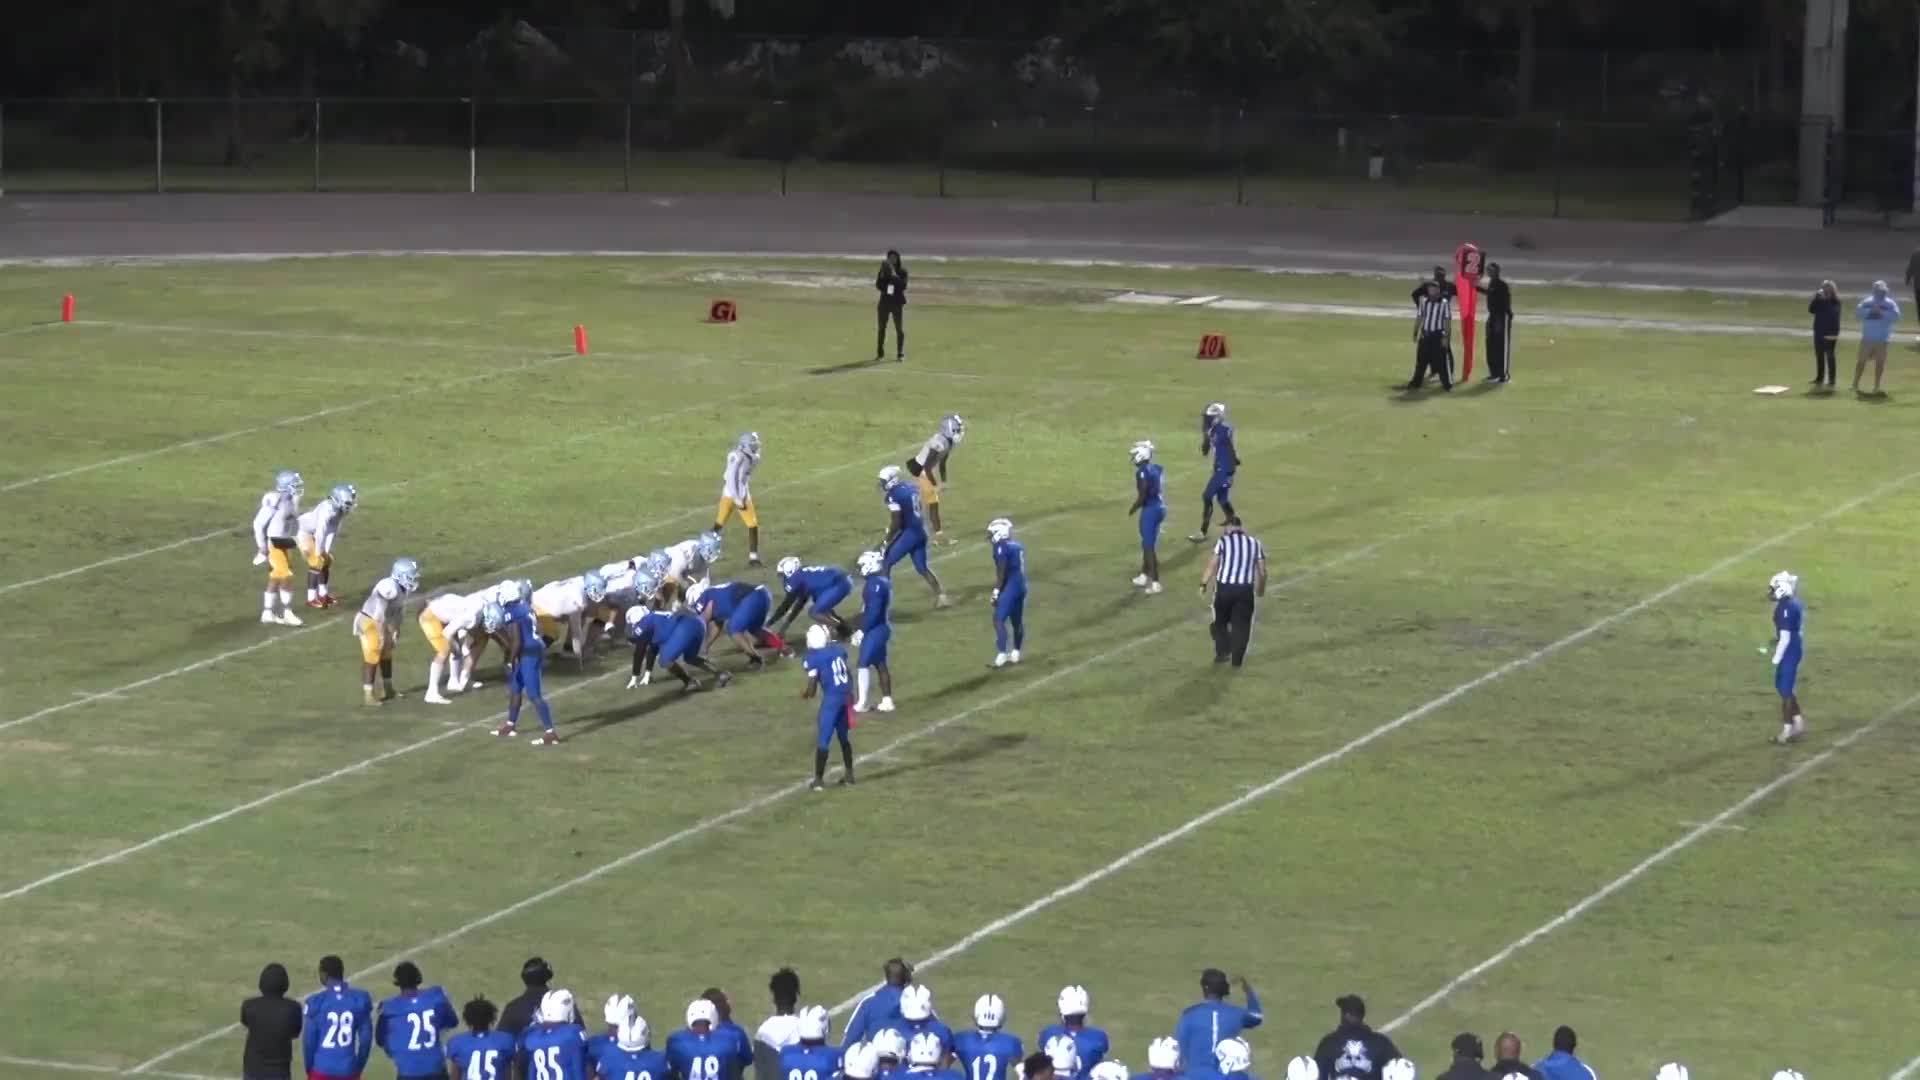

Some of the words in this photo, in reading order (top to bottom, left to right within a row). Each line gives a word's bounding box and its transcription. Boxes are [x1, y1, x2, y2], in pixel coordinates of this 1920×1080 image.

[1465, 251, 1480, 272] 2
[831, 656, 848, 686] 10
[321, 1010, 354, 1048] 28
[407, 1009, 436, 1050] 25
[467, 1050, 498, 1080] 45
[533, 1046, 564, 1080] 85
[972, 1054, 997, 1080] 12
